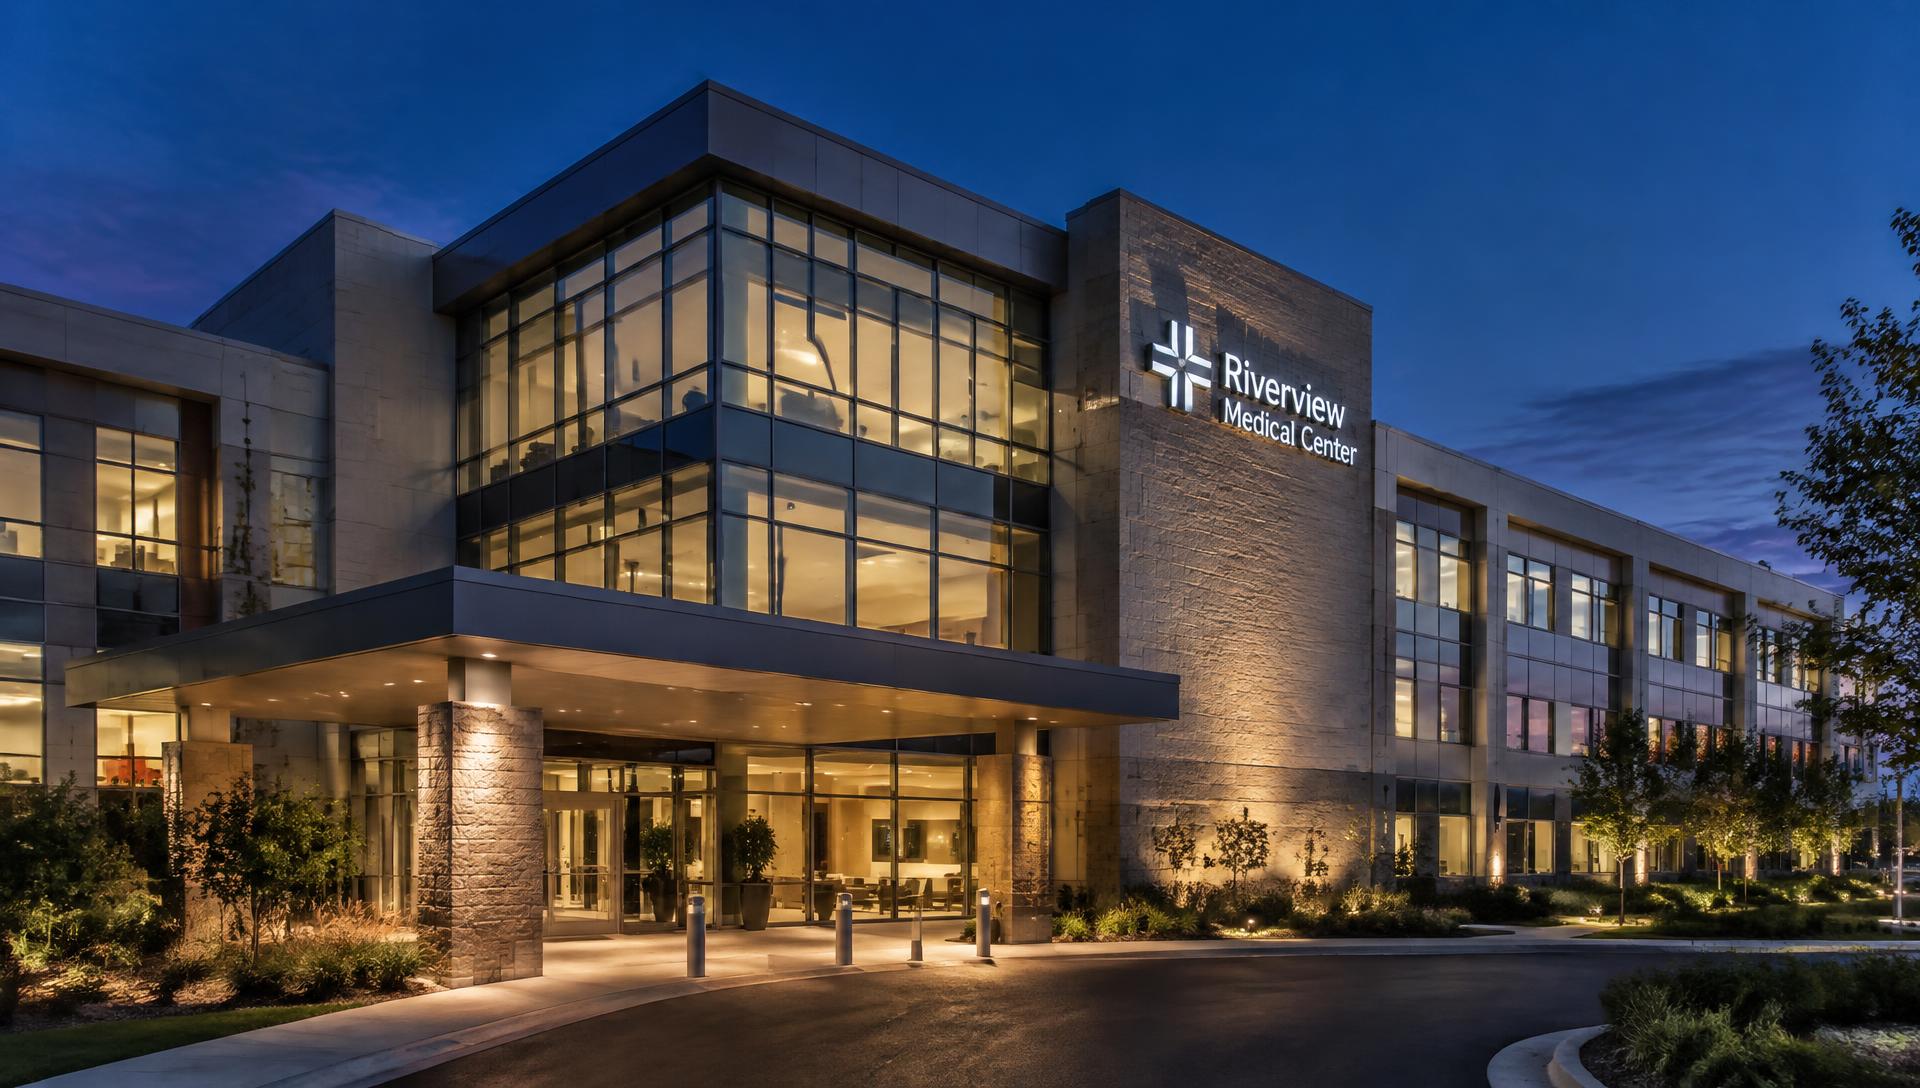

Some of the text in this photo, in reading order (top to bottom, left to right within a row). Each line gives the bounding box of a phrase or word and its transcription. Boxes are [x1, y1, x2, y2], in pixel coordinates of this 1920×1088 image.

[1224, 352, 1345, 428] Riverview
[1224, 397, 1357, 465] Medical Center
